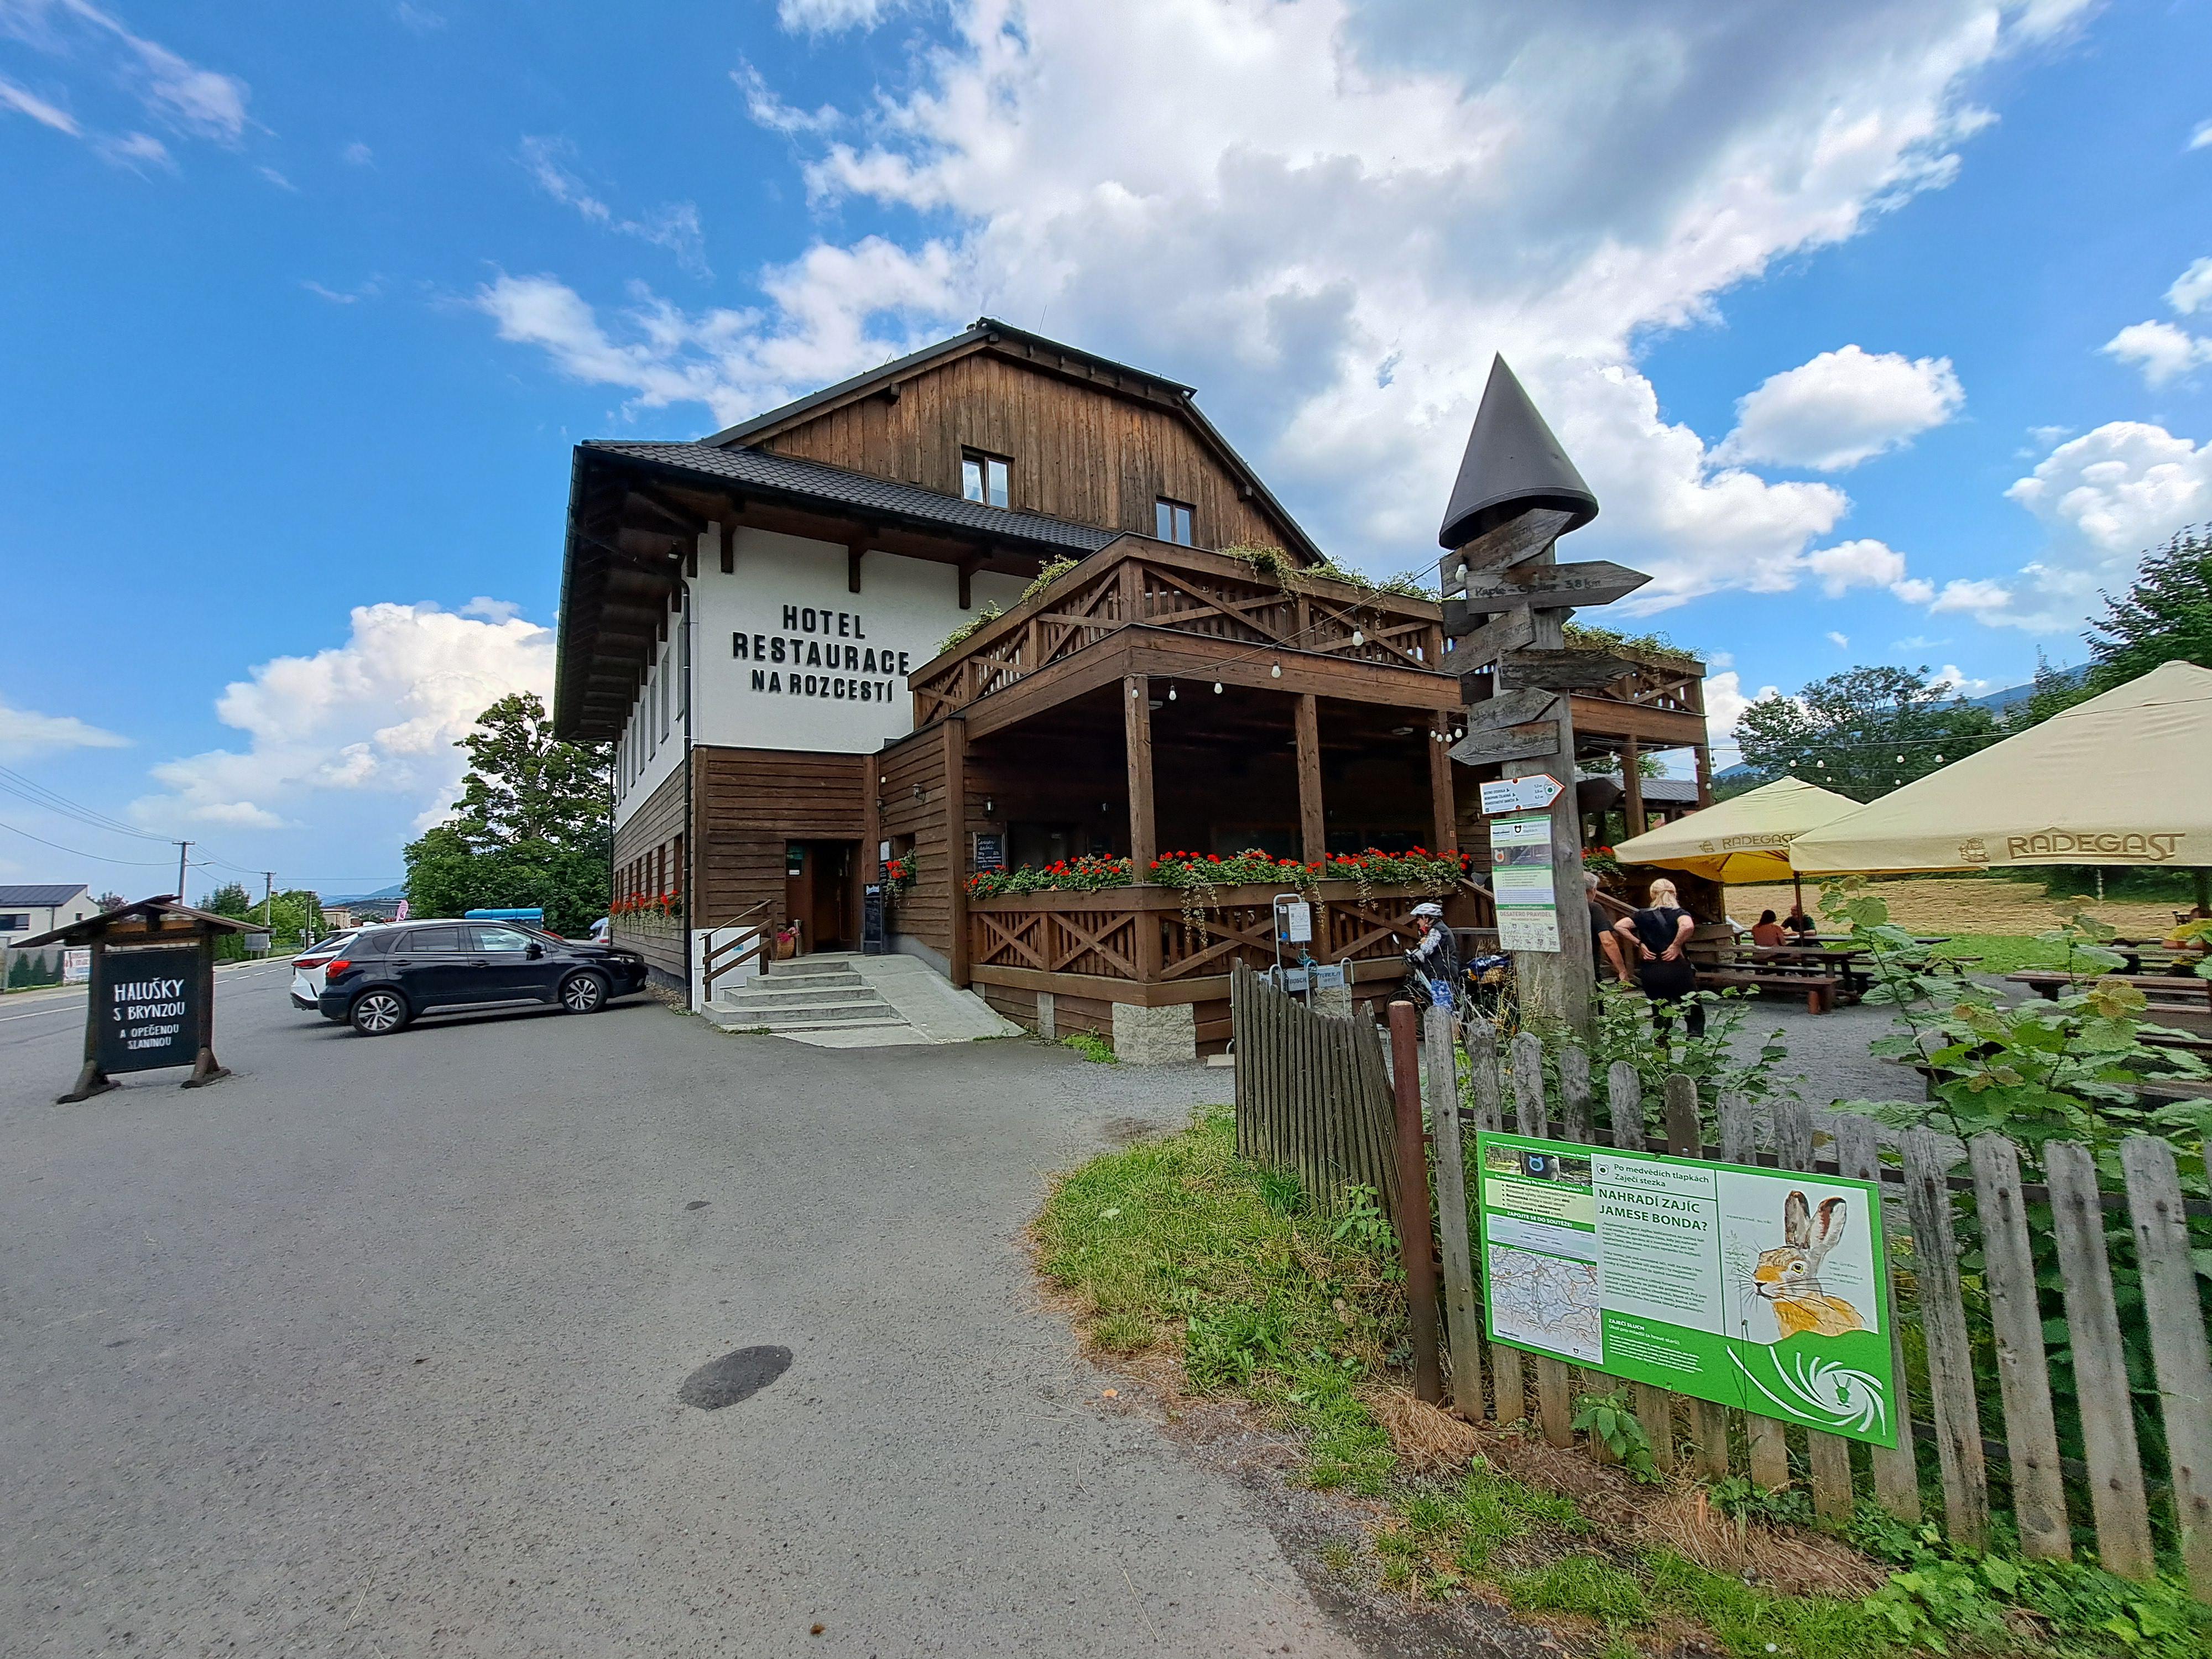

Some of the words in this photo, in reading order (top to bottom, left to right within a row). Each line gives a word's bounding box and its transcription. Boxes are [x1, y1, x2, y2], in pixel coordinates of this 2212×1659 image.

[1584, 580, 1601, 589] km
[783, 604, 865, 639] HOTEL
[733, 632, 910, 676] RESTAURACE
[752, 669, 781, 692] NA
[790, 673, 893, 702] ROZCESTÍ
[1722, 833, 1796, 849] RADEGAST
[2007, 833, 2185, 861] RADEGAST
[114, 977, 184, 1002] HALUŠKY
[113, 1008, 121, 1021] S
[128, 1001, 185, 1020] BRYNZOU
[119, 1029, 126, 1039] A
[131, 1024, 179, 1037] OPEČENOU
[127, 1036, 171, 1049] SLANINOU
[1615, 1173, 1638, 1182] Zaječí
[1640, 1178, 1666, 1187] stezka
[1626, 1166, 1671, 1178] medvědích
[1673, 1172, 1709, 1183] tlapkách
[1599, 1189, 1659, 1207] NAHRADÍ
[1662, 1198, 1700, 1213] ZAJÍC
[1507, 1211, 1530, 1220] ZAPOJTE
[1547, 1217, 1572, 1227] SOUTĚŽE!
[1599, 1205, 1649, 1221] JAMESE
[1652, 1214, 1708, 1231] BONDA?
[1608, 1318, 1626, 1326] ZAJEČÍ
[1626, 1322, 1645, 1331] SLUCH
